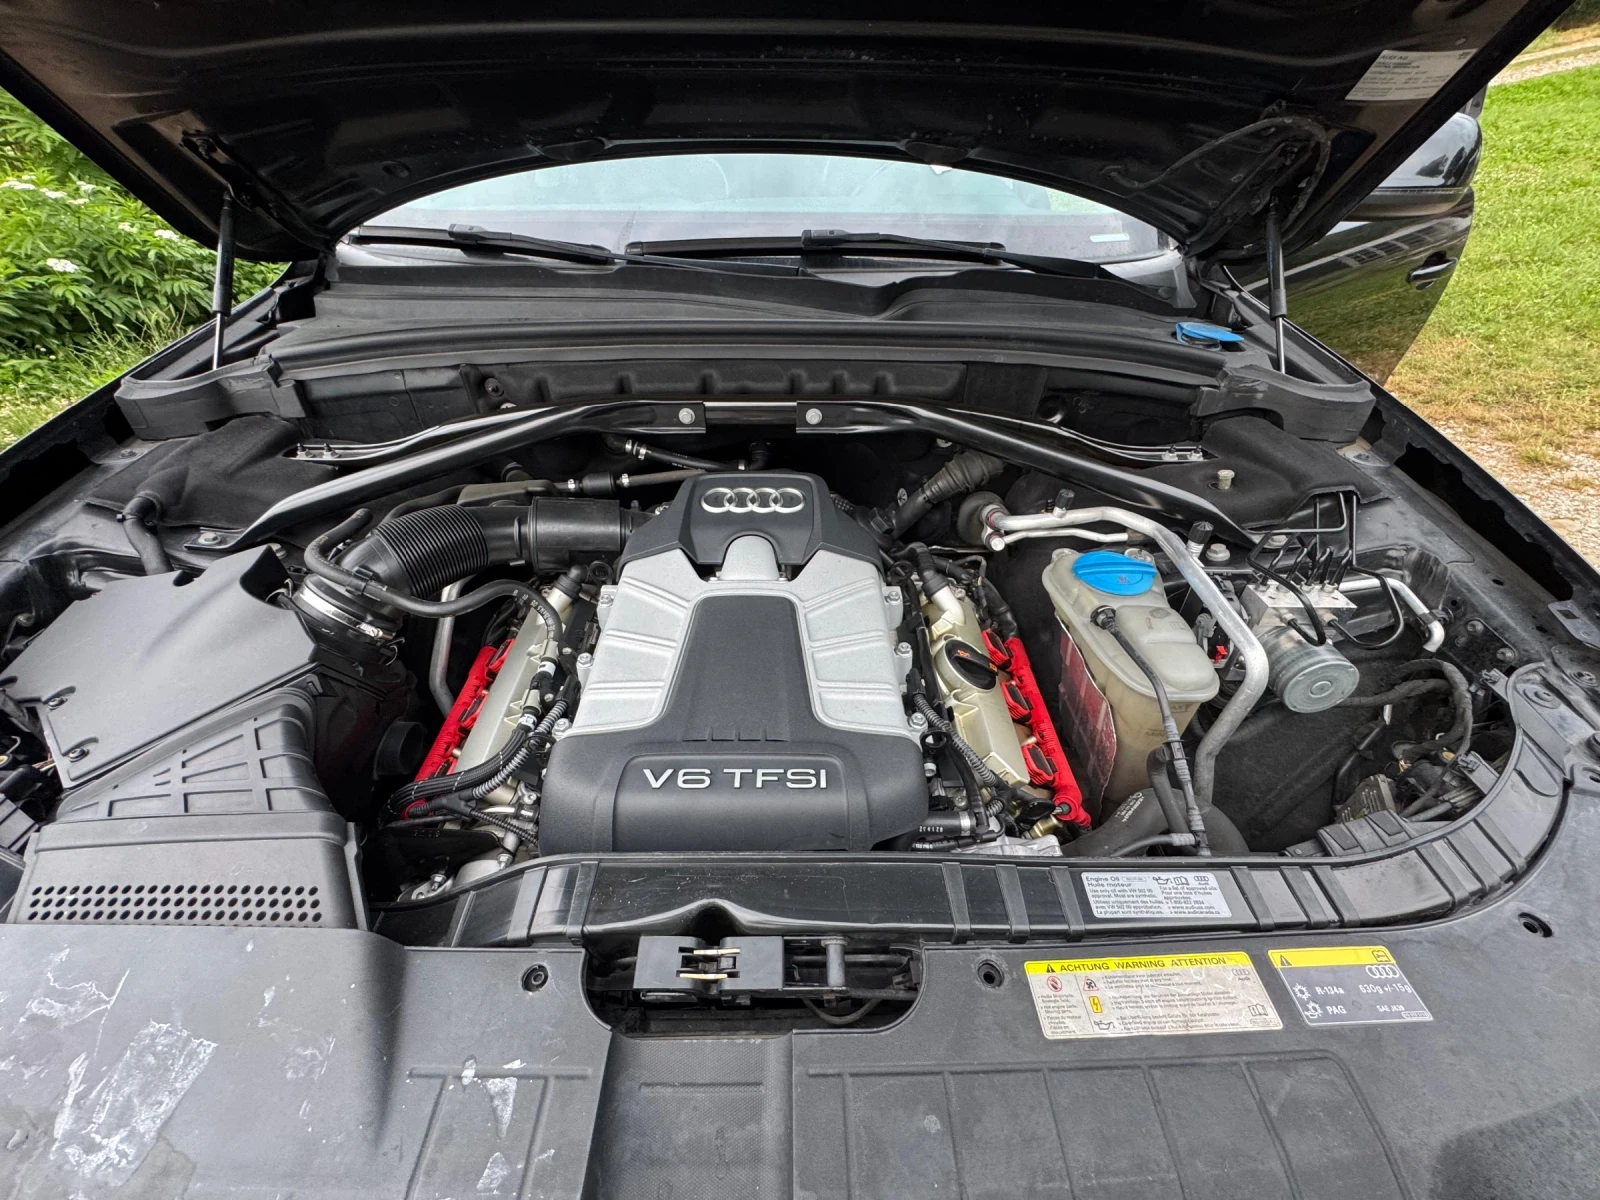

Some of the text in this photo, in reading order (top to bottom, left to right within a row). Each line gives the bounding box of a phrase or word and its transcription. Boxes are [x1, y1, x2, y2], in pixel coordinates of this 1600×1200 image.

[642, 768, 827, 789] V6 TFSI
[1060, 957, 1226, 972] ACHTUNG WARNING ATTENTION
[1316, 986, 1345, 995] R-134a
[1325, 1006, 1347, 1014] PAG
